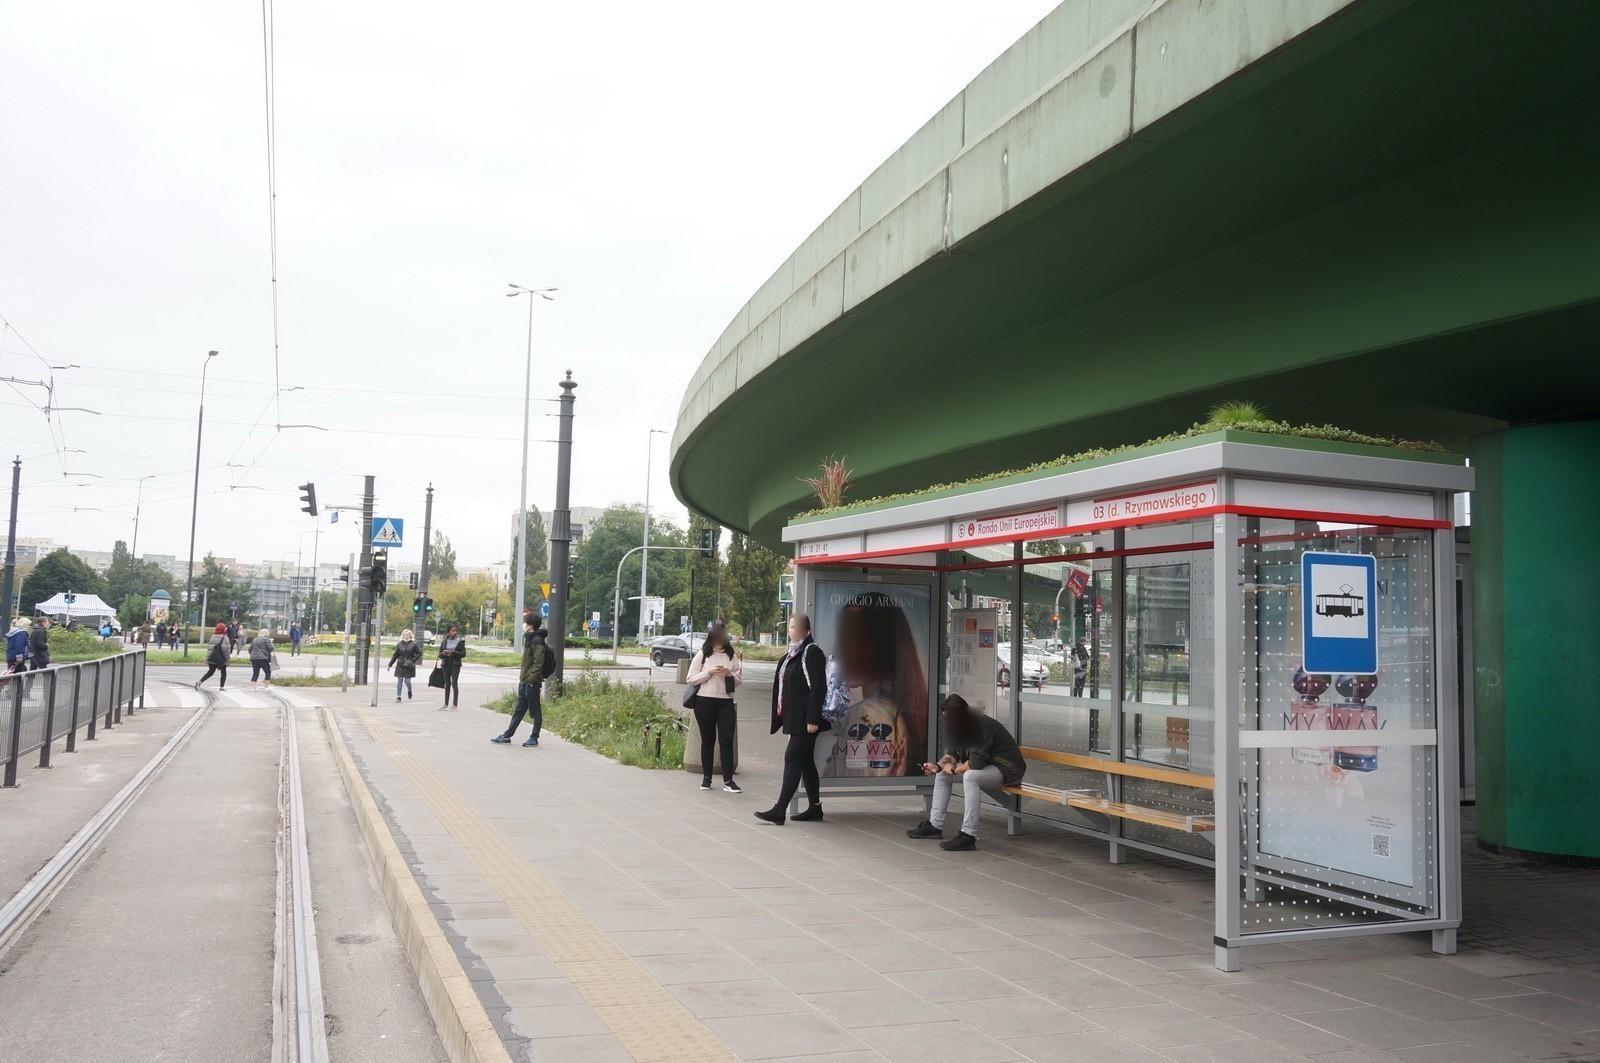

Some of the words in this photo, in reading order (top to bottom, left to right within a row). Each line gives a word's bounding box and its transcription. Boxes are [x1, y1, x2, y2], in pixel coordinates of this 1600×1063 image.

[1094, 505, 1104, 519] 03
[1108, 503, 1120, 519] (d.
[1125, 492, 1206, 516] Rzymowskiego
[978, 522, 998, 536] Rondo
[1000, 521, 1012, 533] Unii
[1014, 512, 1057, 530] Europejskiej
[831, 592, 873, 606] GIORGIO
[877, 594, 914, 609] ARMANI
[837, 743, 860, 756] MY
[867, 744, 900, 756] WAY
